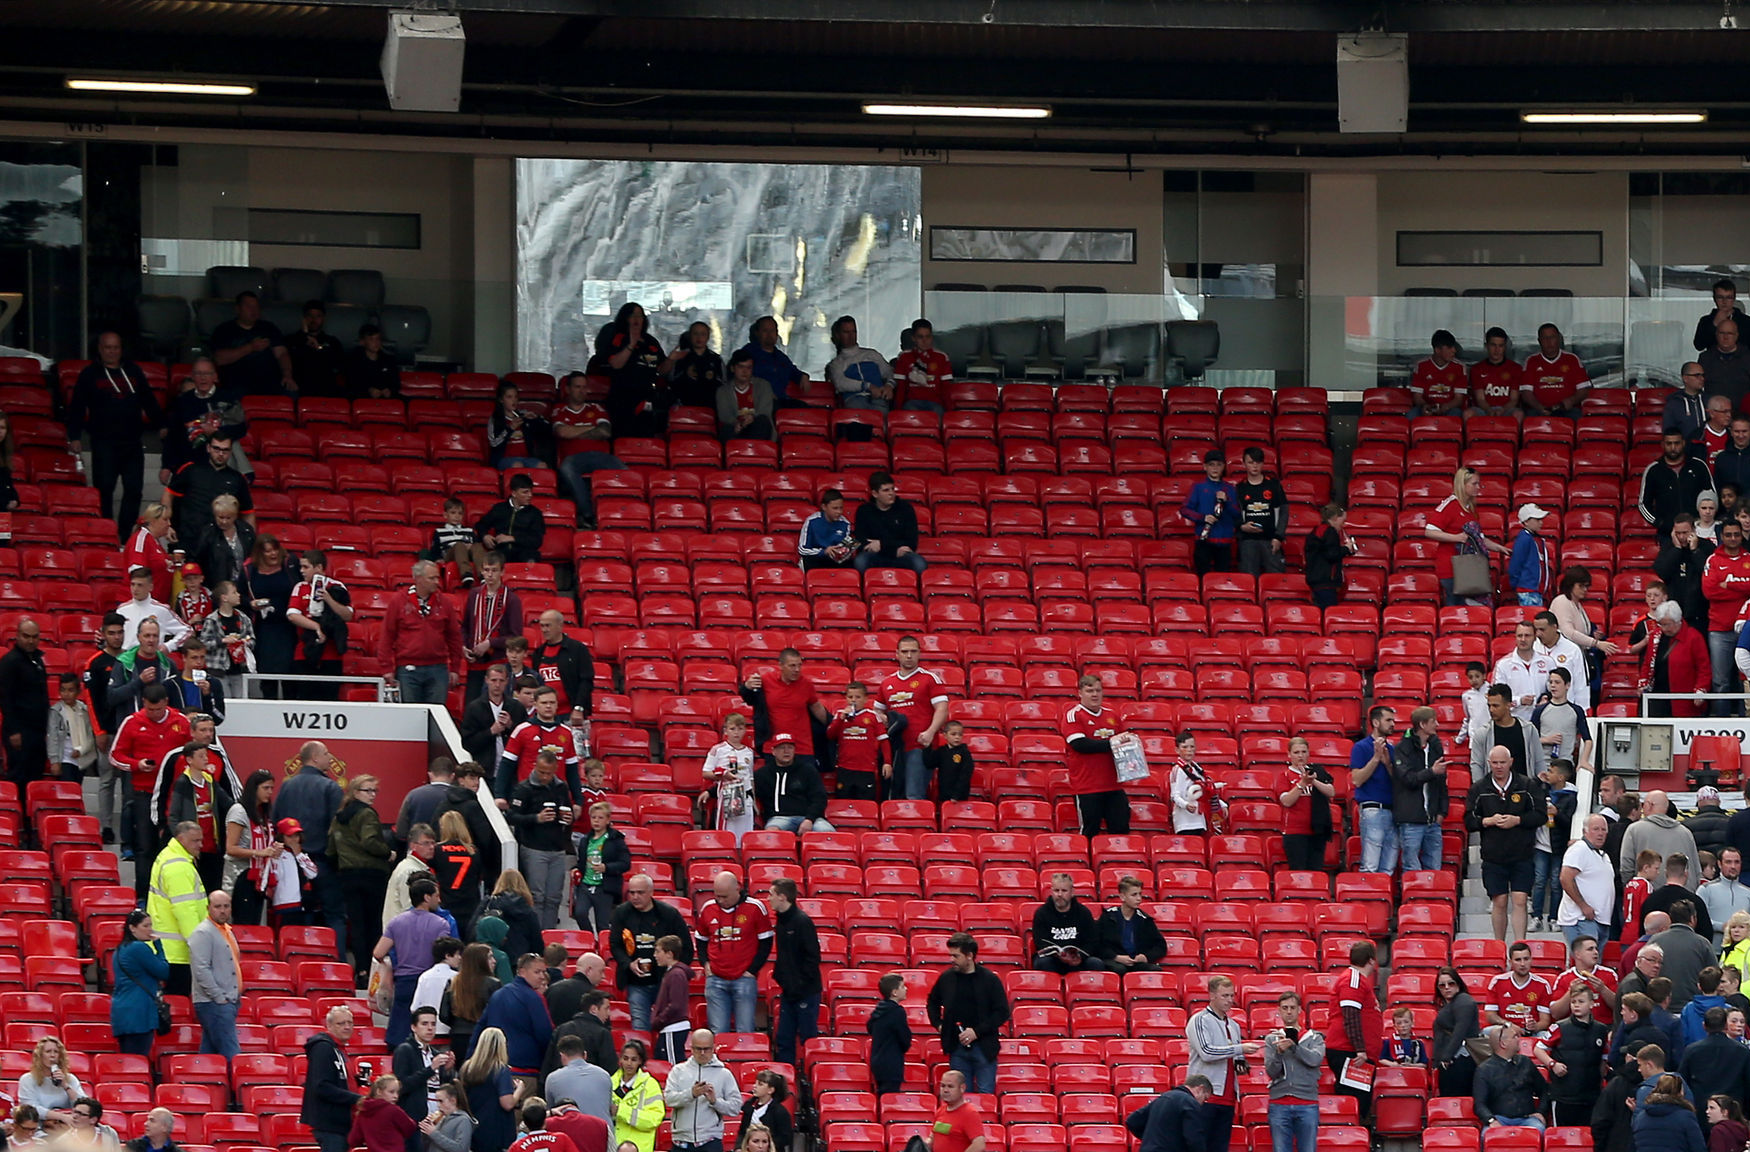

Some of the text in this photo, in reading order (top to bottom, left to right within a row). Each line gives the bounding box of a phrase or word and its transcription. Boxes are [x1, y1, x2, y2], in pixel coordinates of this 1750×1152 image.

[1485, 383, 1510, 397] AON
[283, 711, 348, 731] W210
[449, 856, 471, 890] 7
[521, 1134, 558, 1151] MEMPHIS
